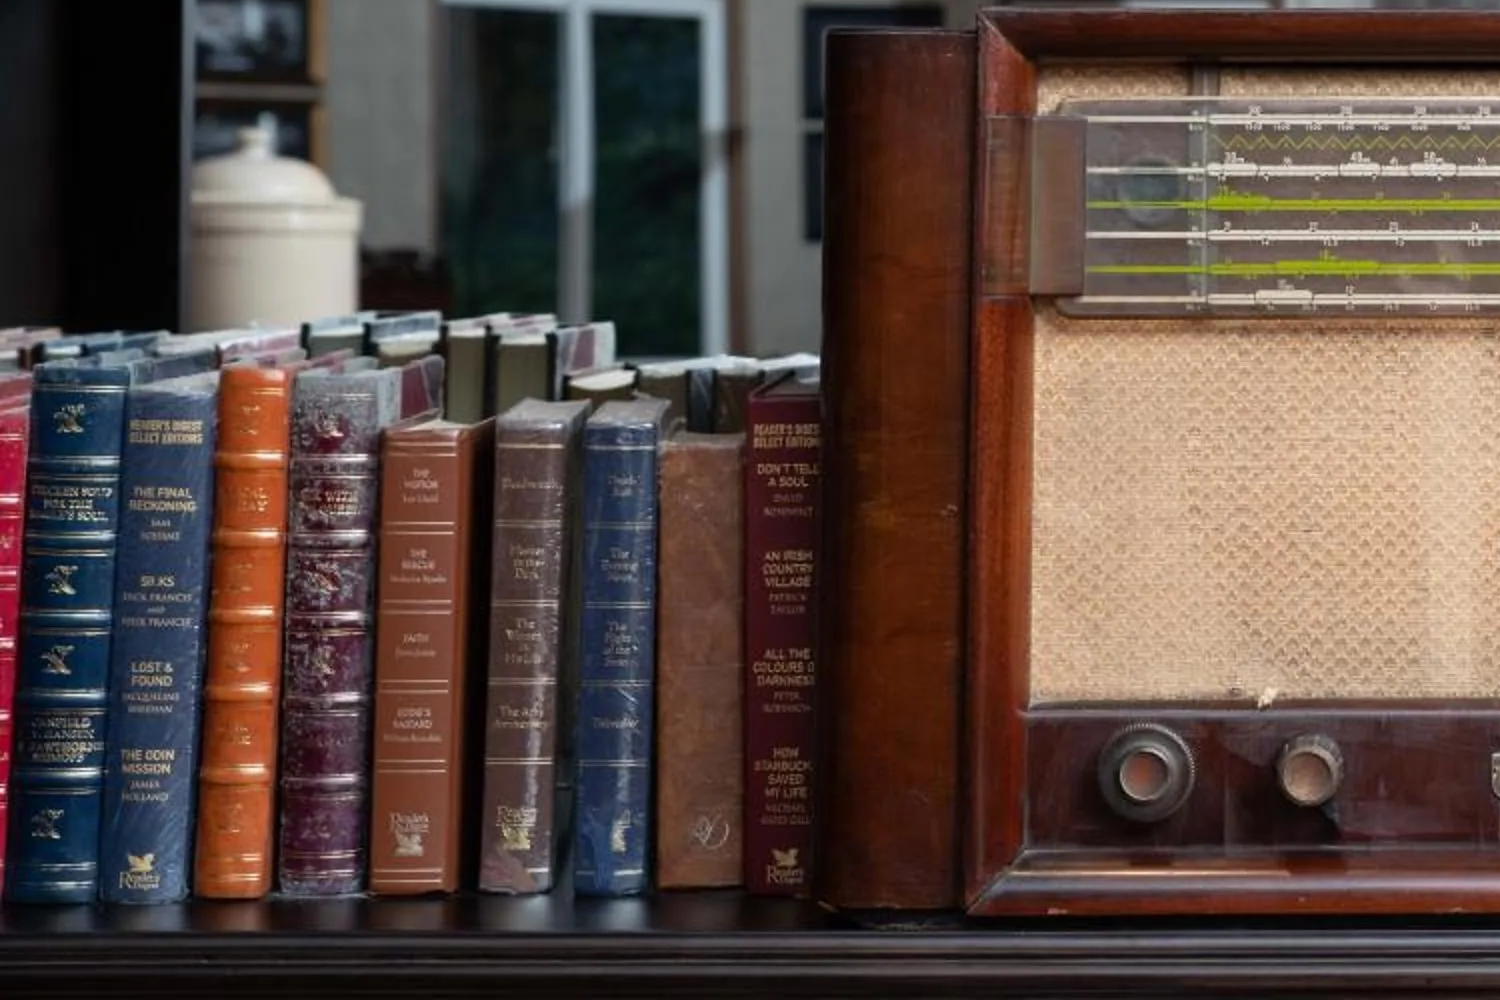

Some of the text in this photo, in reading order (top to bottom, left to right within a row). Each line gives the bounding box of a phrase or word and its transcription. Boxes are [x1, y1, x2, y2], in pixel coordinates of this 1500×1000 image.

[161, 433, 203, 444] EDITIONS
[757, 464, 819, 475] DON'T TELL
[768, 477, 808, 487] A SOUL
[157, 487, 192, 499] FINAL
[130, 501, 196, 512] RECKONING
[765, 551, 813, 561] AN IRISH
[762, 564, 813, 574] COUNTRY
[140, 576, 175, 587] SILKS
[765, 577, 811, 587] VILLAGE
[150, 592, 192, 601] FRANCIS
[149, 618, 192, 627] FRANCIS
[764, 649, 811, 659] ALL THE
[131, 662, 174, 673] LOST &
[753, 662, 804, 673] COLOURS
[131, 675, 173, 687] FOUND
[121, 750, 142, 761] THE
[773, 749, 799, 758] HOW
[122, 763, 171, 774] MISSION
[768, 774, 802, 785] SAVED
[122, 793, 169, 802] HOLLAND
[765, 788, 806, 798] MY LIFE
